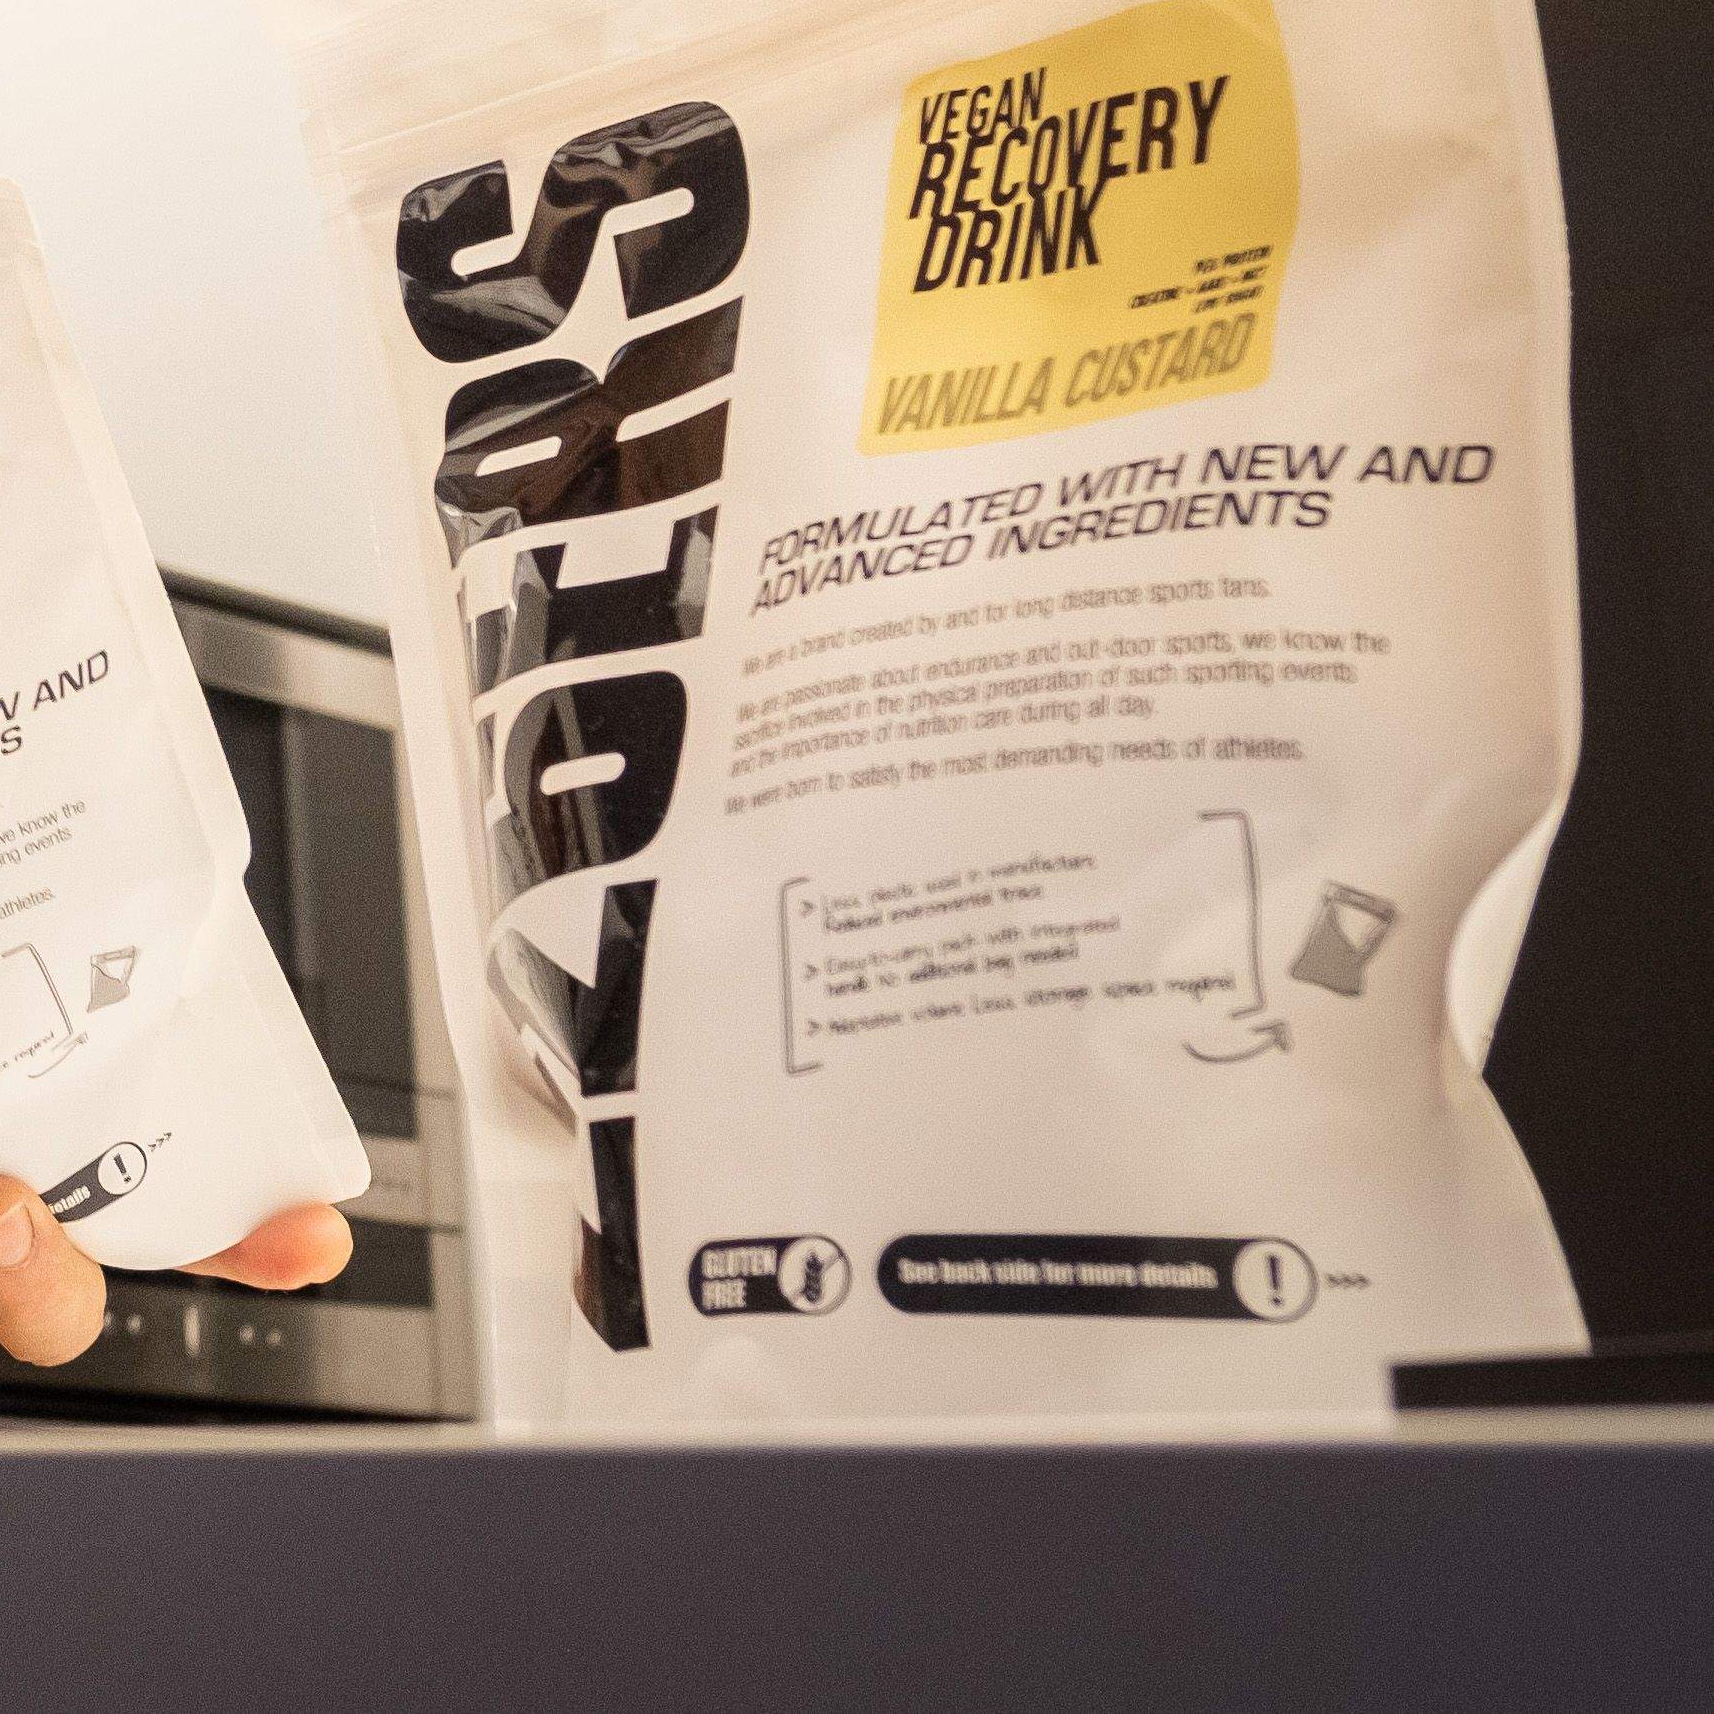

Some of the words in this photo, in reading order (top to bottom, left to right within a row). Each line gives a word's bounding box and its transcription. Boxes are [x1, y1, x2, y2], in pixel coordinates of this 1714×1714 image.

[908, 75, 1231, 221] RECOVERY
[920, 66, 1050, 146] VEGAN
[912, 176, 1110, 294] DRINK
[877, 354, 1057, 437] VANILLA
[1063, 311, 1259, 411] CUSTARD
[750, 527, 975, 618] ADVANCED
[985, 488, 1334, 562] INGREDIENTS
[759, 480, 1045, 577] FORMULATED
[1054, 451, 1188, 512] WITH
[1197, 442, 1349, 486] NEW
[1355, 442, 1497, 486] AND
[31, 648, 111, 712] AND
[18, 811, 60, 836] know
[62, 799, 87, 820] the
